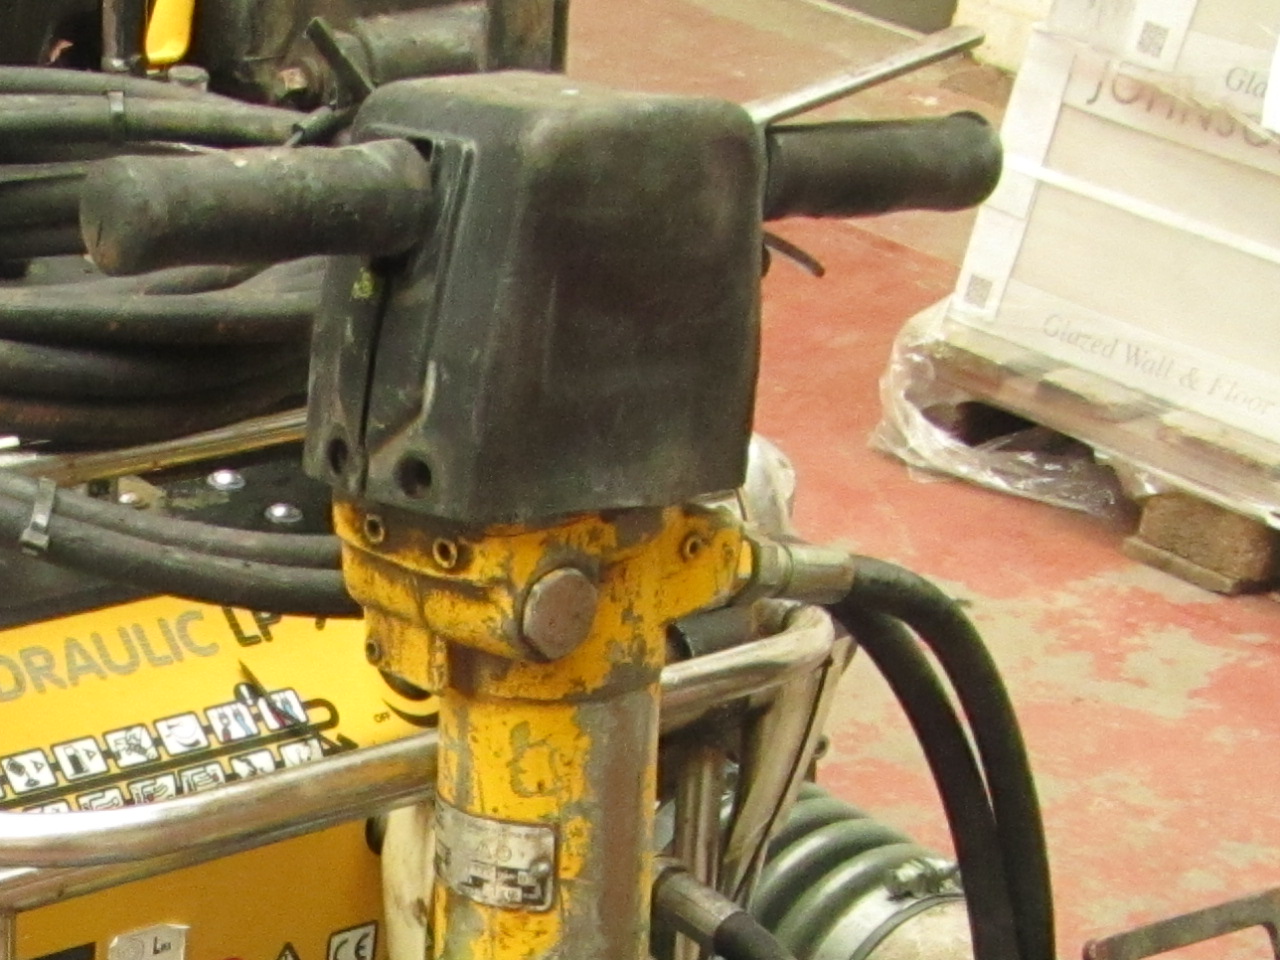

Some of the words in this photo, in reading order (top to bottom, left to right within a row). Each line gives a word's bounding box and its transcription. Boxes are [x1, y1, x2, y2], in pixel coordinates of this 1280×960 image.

[1042, 313, 1120, 359] Glazed
[1124, 342, 1177, 378] Wall
[1179, 367, 1201, 391] &
